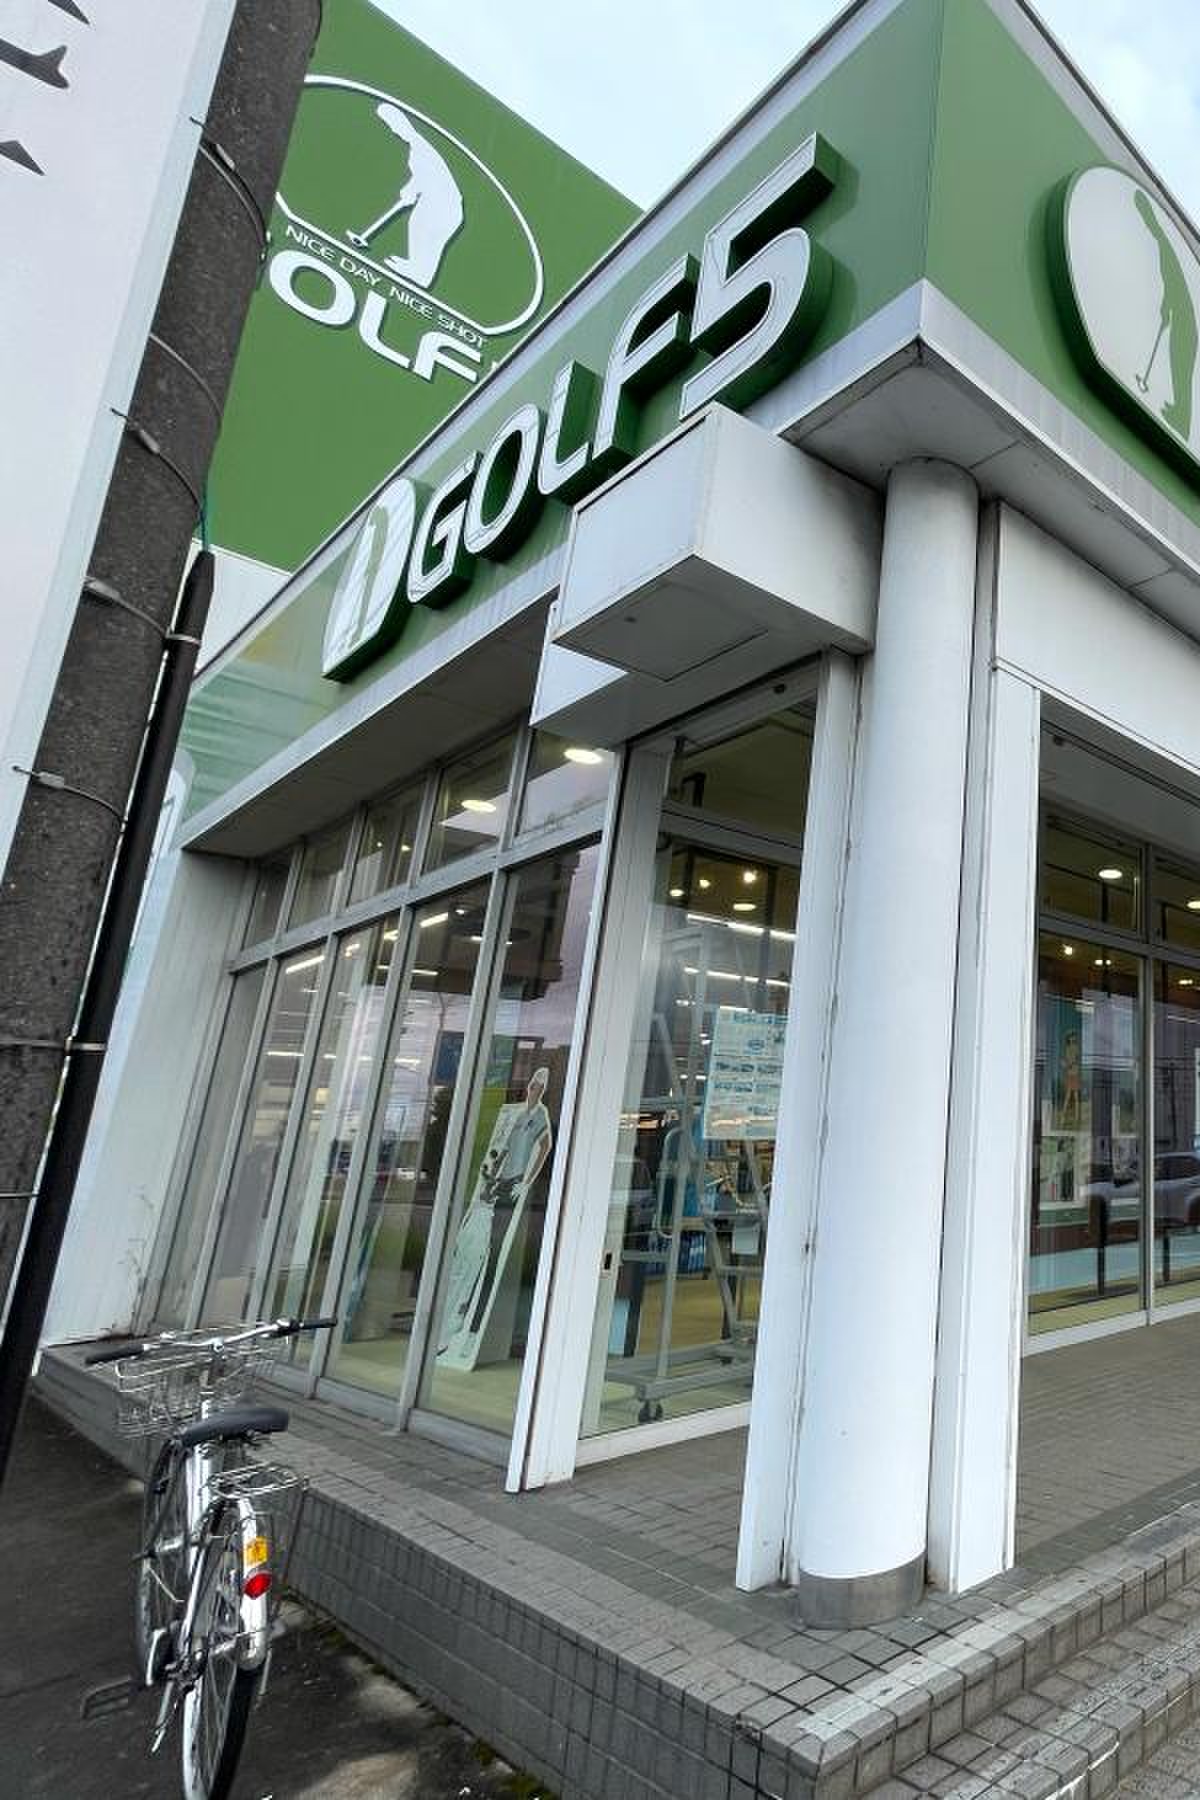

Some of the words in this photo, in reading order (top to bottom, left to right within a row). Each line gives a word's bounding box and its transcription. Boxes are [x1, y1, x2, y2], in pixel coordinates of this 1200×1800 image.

[286, 225, 336, 260] NICE
[339, 256, 382, 287] DAY
[389, 286, 433, 320] NICE
[437, 313, 489, 349] SHOT
